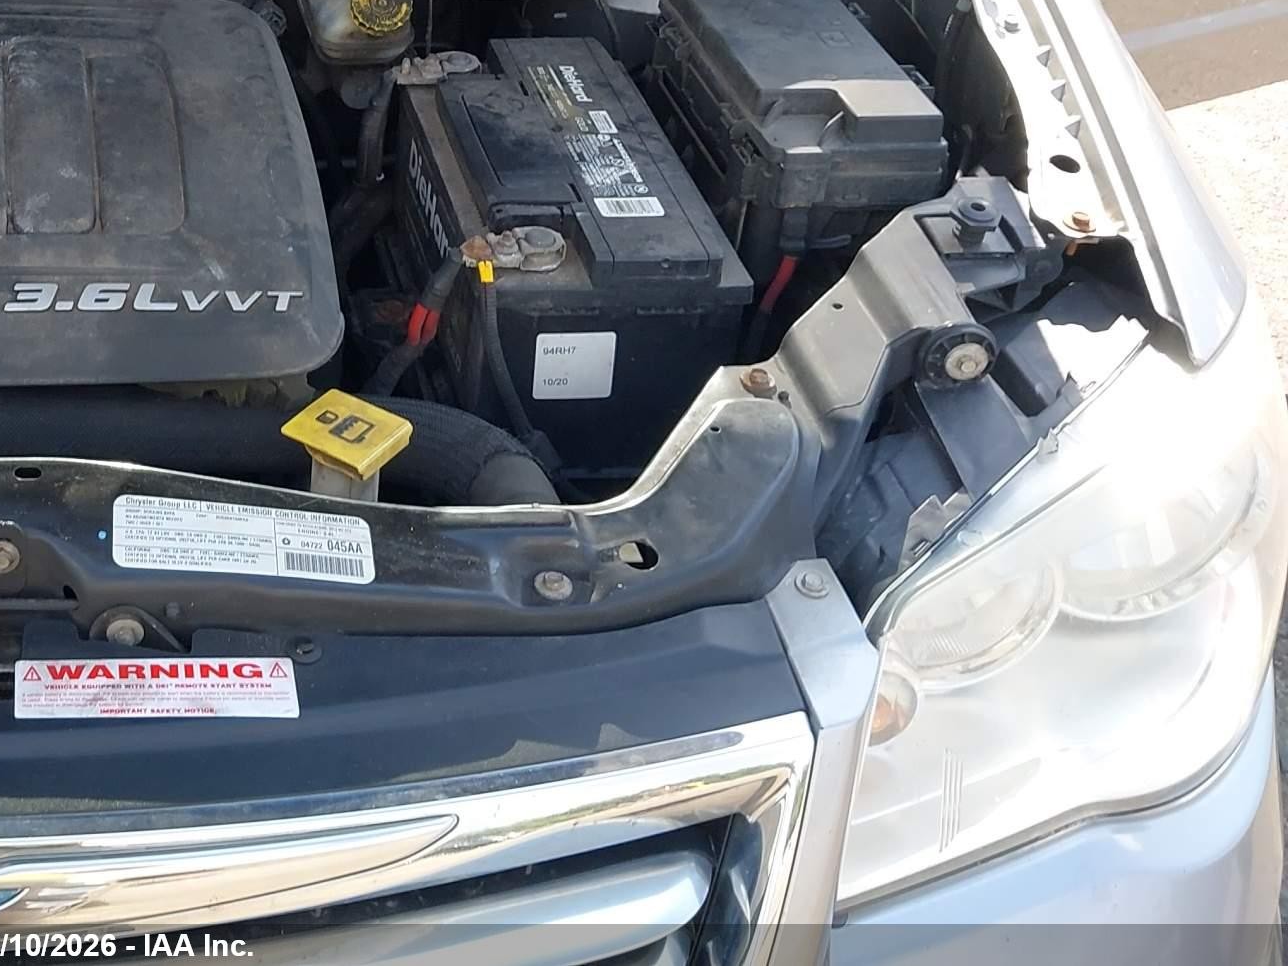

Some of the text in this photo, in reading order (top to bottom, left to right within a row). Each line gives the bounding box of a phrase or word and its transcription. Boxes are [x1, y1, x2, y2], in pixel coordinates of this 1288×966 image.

[558, 65, 593, 103] DieHard
[542, 378, 568, 386] 10/20
[125, 497, 360, 526] Chrysler Group LLC VEHICLE EMISSION CONTROL INFORMATION
[300, 539, 363, 554] 04722 045AA
[46, 663, 263, 680] WARNING
